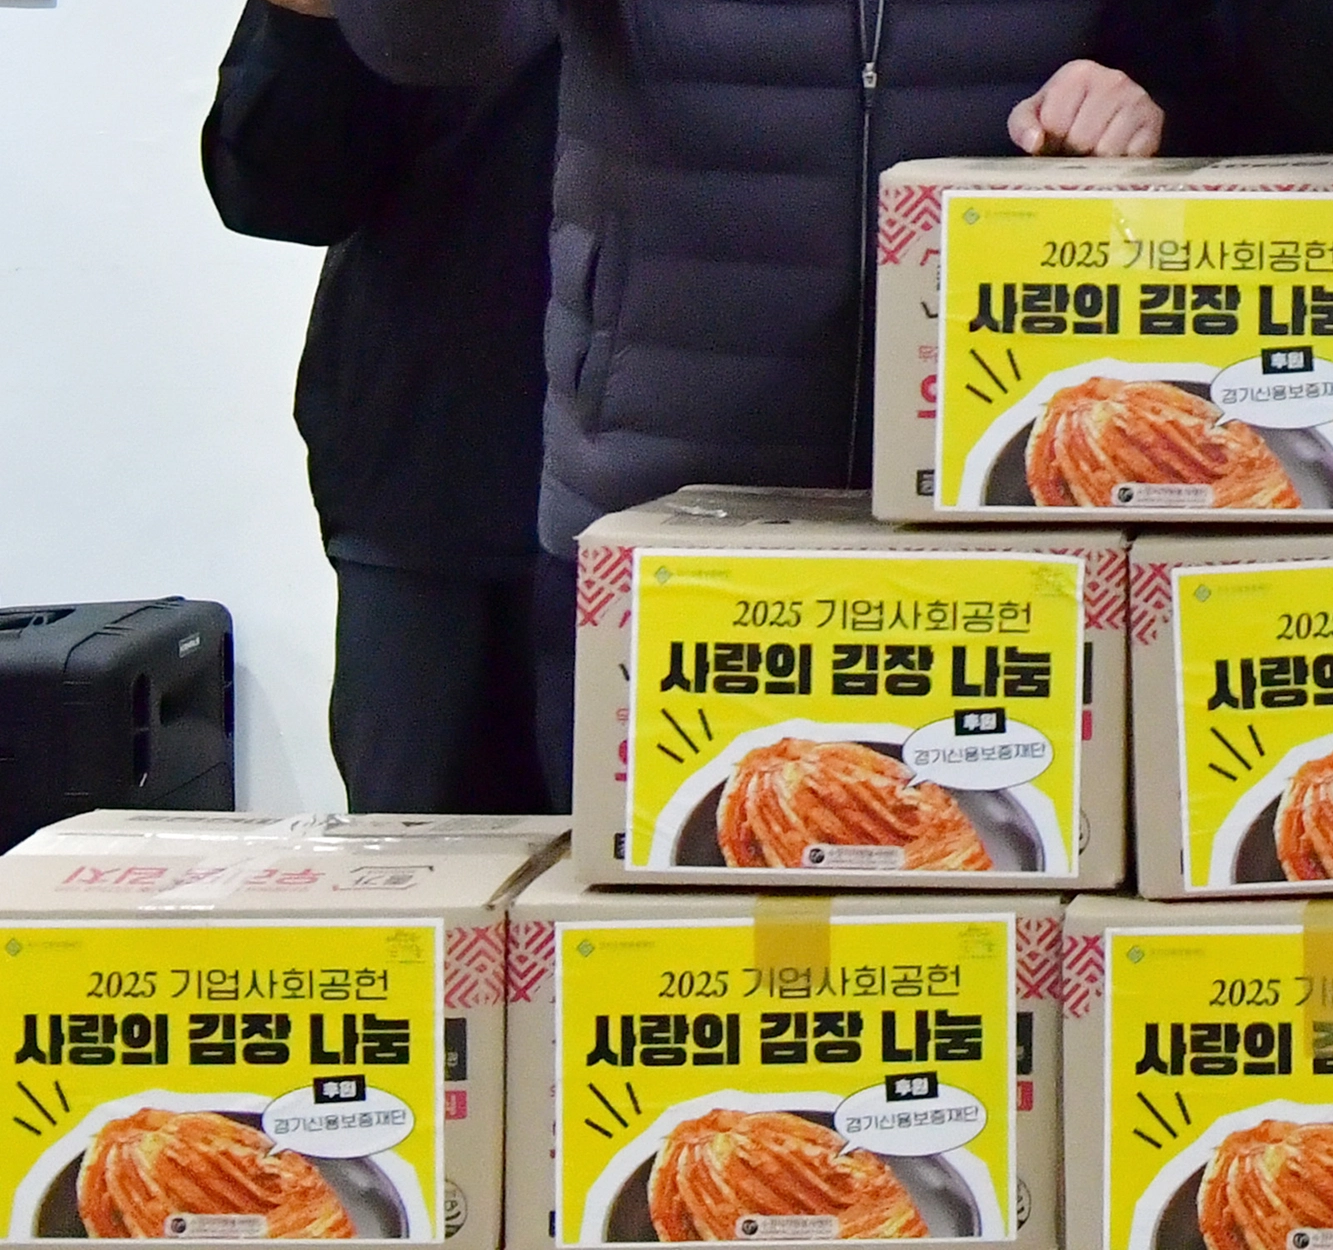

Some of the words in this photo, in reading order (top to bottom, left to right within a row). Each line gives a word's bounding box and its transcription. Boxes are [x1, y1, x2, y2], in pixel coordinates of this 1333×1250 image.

[1040, 241, 1110, 269] 2025
[967, 283, 1121, 336] 사랑의
[1139, 284, 1242, 336] 김장
[1272, 352, 1304, 369] 후원
[732, 600, 803, 628] 2025
[816, 599, 1030, 633] 기업사회공헌
[658, 641, 813, 696] 사랑의
[832, 644, 935, 697] 김장
[951, 645, 1051, 698] 나눔
[964, 713, 996, 730] 후원
[914, 743, 1045, 766] 경기신용보증재단
[87, 971, 157, 998] 2025
[170, 967, 388, 1001] 기업사회공헌
[658, 971, 729, 999] 2025
[742, 963, 960, 999] 기업사회공헌
[1209, 979, 1280, 1007] 2025
[14, 1013, 169, 1066] 사랑의
[188, 1013, 292, 1066] 김장
[309, 1013, 410, 1065] 나눔
[585, 1013, 741, 1067] 사랑의
[760, 1011, 864, 1065] 김장
[881, 1009, 982, 1062] 나눔
[1134, 1022, 1293, 1076] 사랑의
[324, 1081, 356, 1098] 후원
[896, 1078, 928, 1096] 후원
[274, 1110, 406, 1134] 경기신용보증재단
[846, 1106, 978, 1133] 경기신용보증재단
